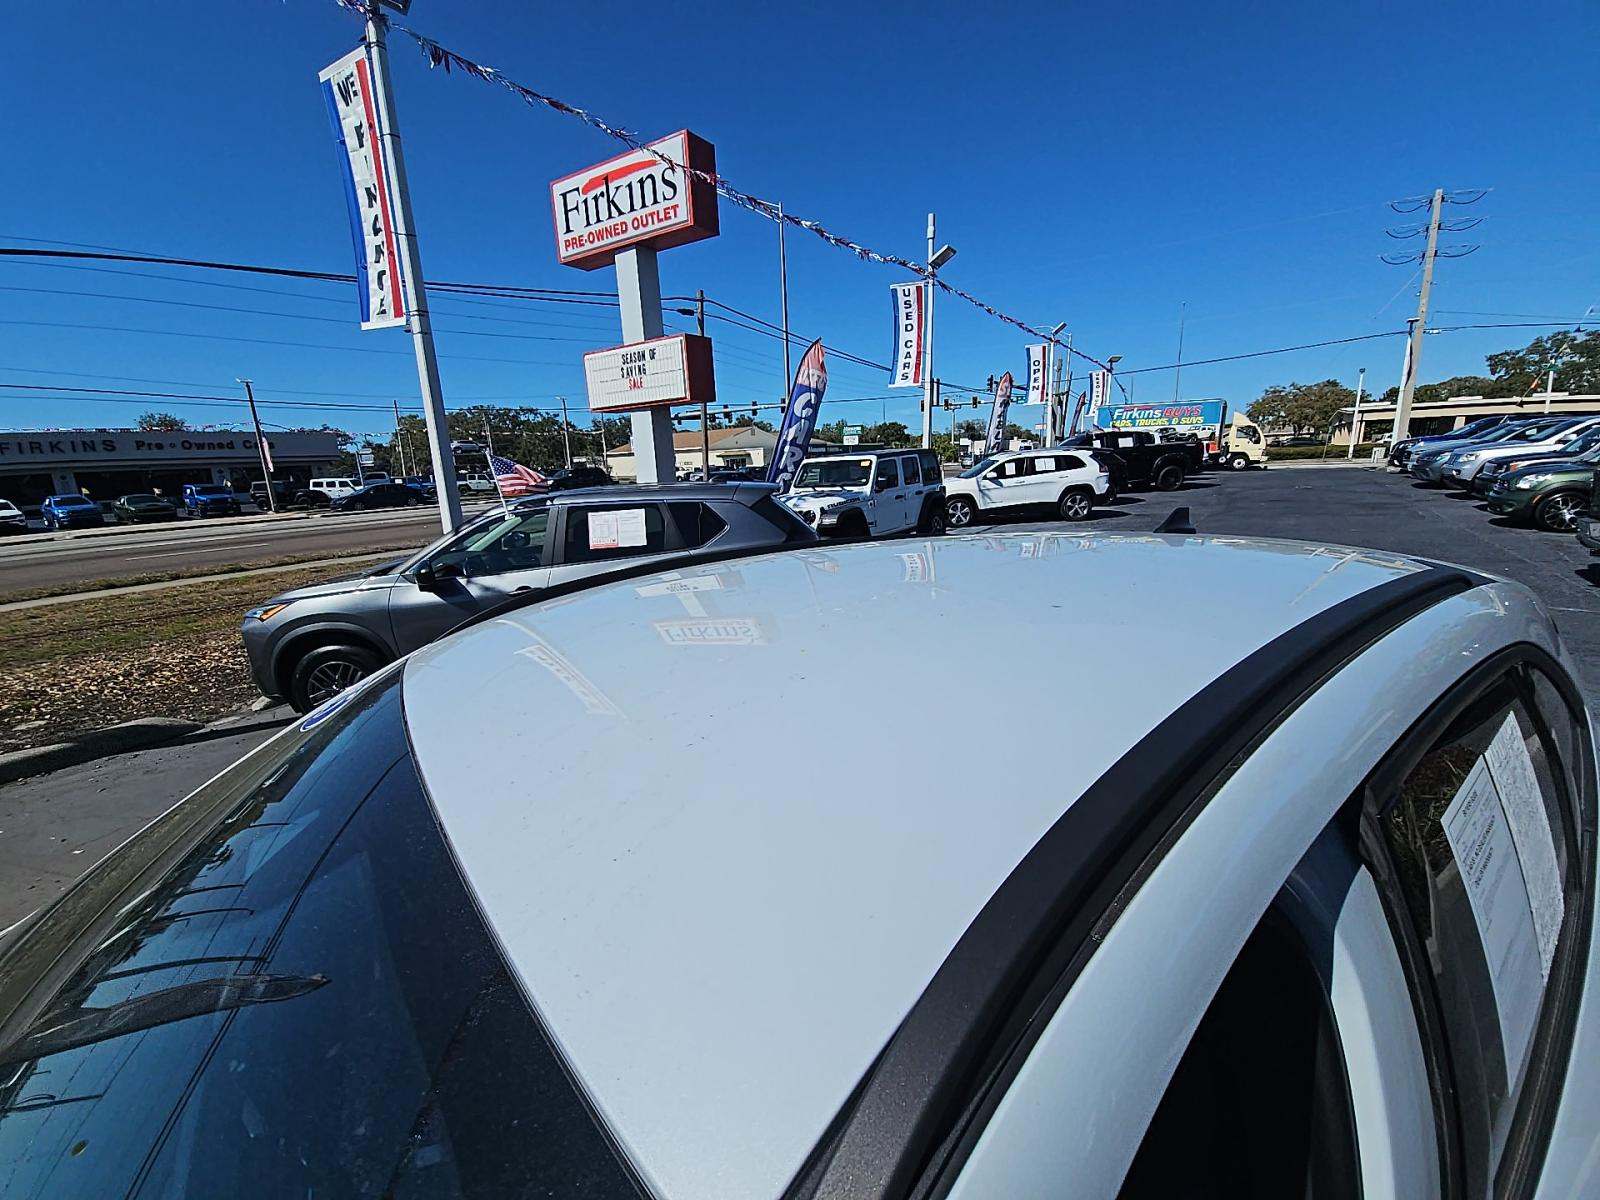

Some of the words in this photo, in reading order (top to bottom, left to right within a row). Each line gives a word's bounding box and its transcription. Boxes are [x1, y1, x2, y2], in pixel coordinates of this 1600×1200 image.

[337, 72, 359, 107] WE
[558, 166, 678, 235] Firkins
[564, 221, 629, 251] PRE-OWNED
[631, 204, 680, 231] OUTLET
[902, 288, 914, 333] USED
[620, 363, 647, 378] SAVING
[621, 349, 646, 366] SEASON
[648, 348, 657, 360] OF
[900, 339, 914, 381] CARS
[628, 377, 644, 390] SALE
[1032, 359, 1041, 392] OPEN
[1113, 406, 1162, 420] Firkins
[0, 439, 117, 455] FIRKINS
[242, 439, 275, 450] Cas
